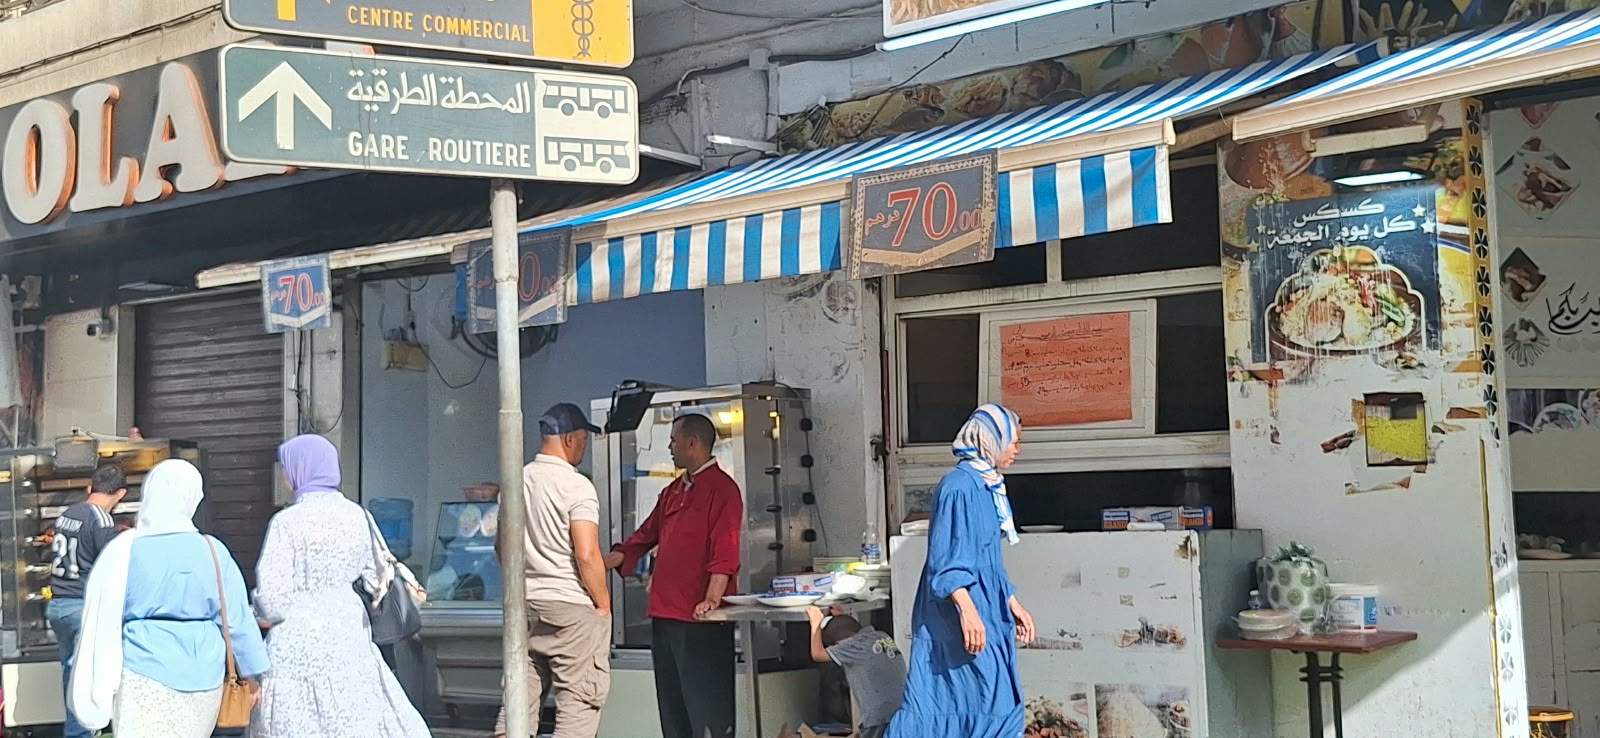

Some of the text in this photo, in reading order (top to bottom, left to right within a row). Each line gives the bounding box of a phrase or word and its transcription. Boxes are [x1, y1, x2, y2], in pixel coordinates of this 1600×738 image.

[347, 5, 530, 43] CENTRE COMMERCIAL
[346, 68, 531, 115] المحطة الطرقية
[2, 61, 298, 225] OLA
[348, 131, 532, 168] GARE ROUTIERE
[1267, 214, 1418, 249] كل يوم الجمعة
[1293, 198, 1385, 228] كسكس
[51, 532, 80, 579] 21
